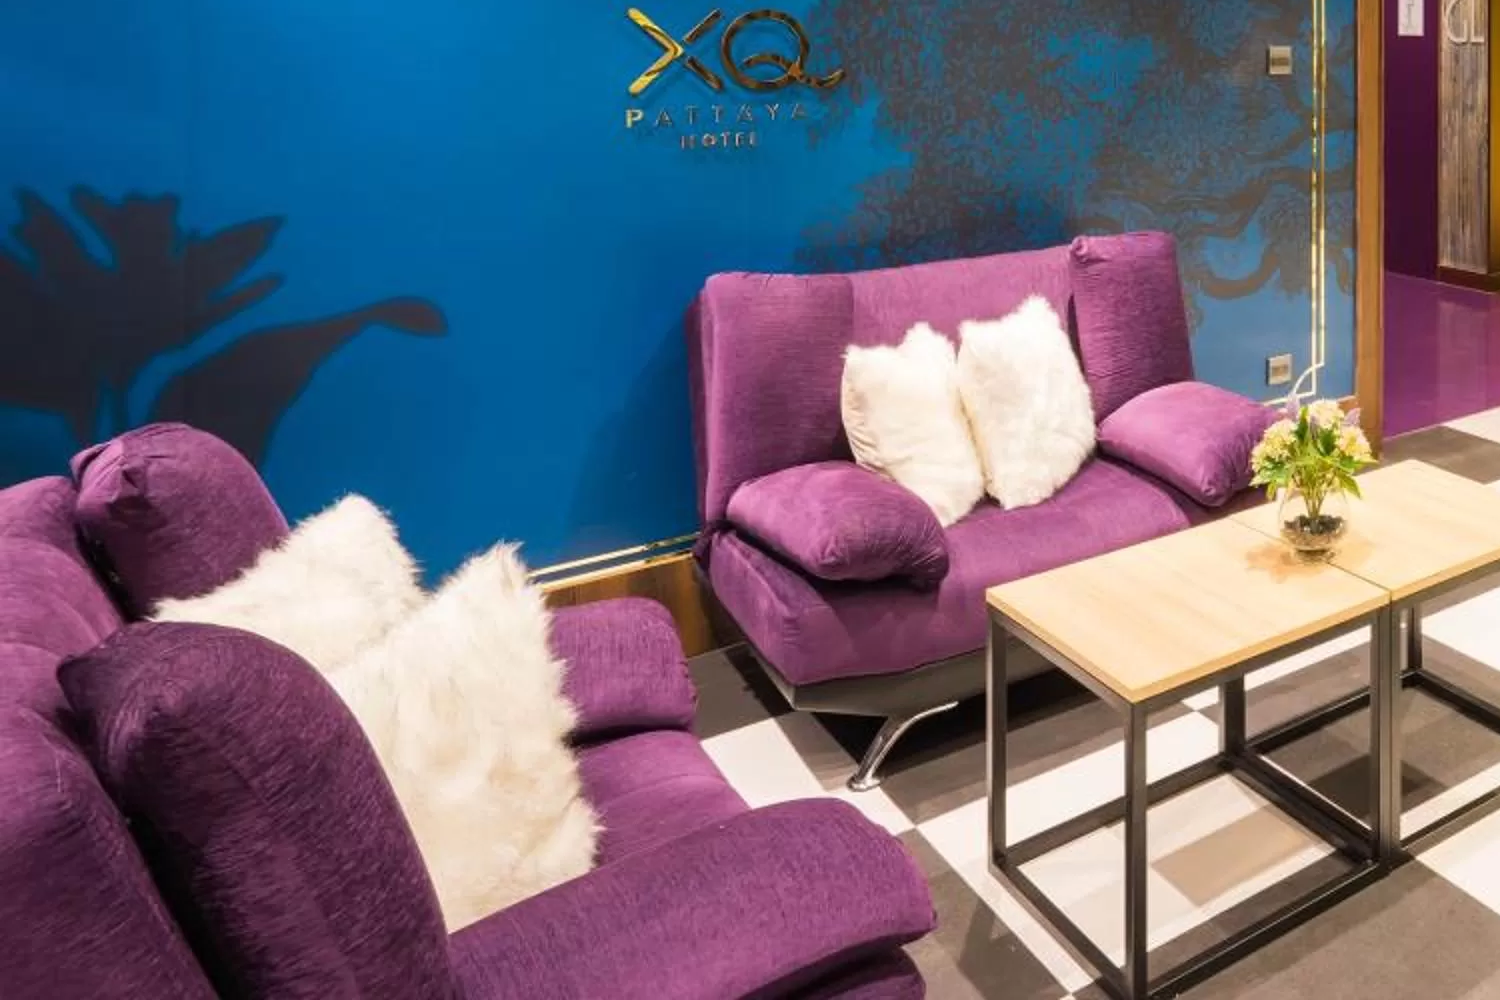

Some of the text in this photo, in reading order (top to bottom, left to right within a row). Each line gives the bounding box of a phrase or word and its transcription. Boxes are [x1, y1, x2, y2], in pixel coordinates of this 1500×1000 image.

[627, 7, 846, 98] XQ
[625, 103, 808, 129] PATTAYA
[680, 130, 758, 150] HOTEL
